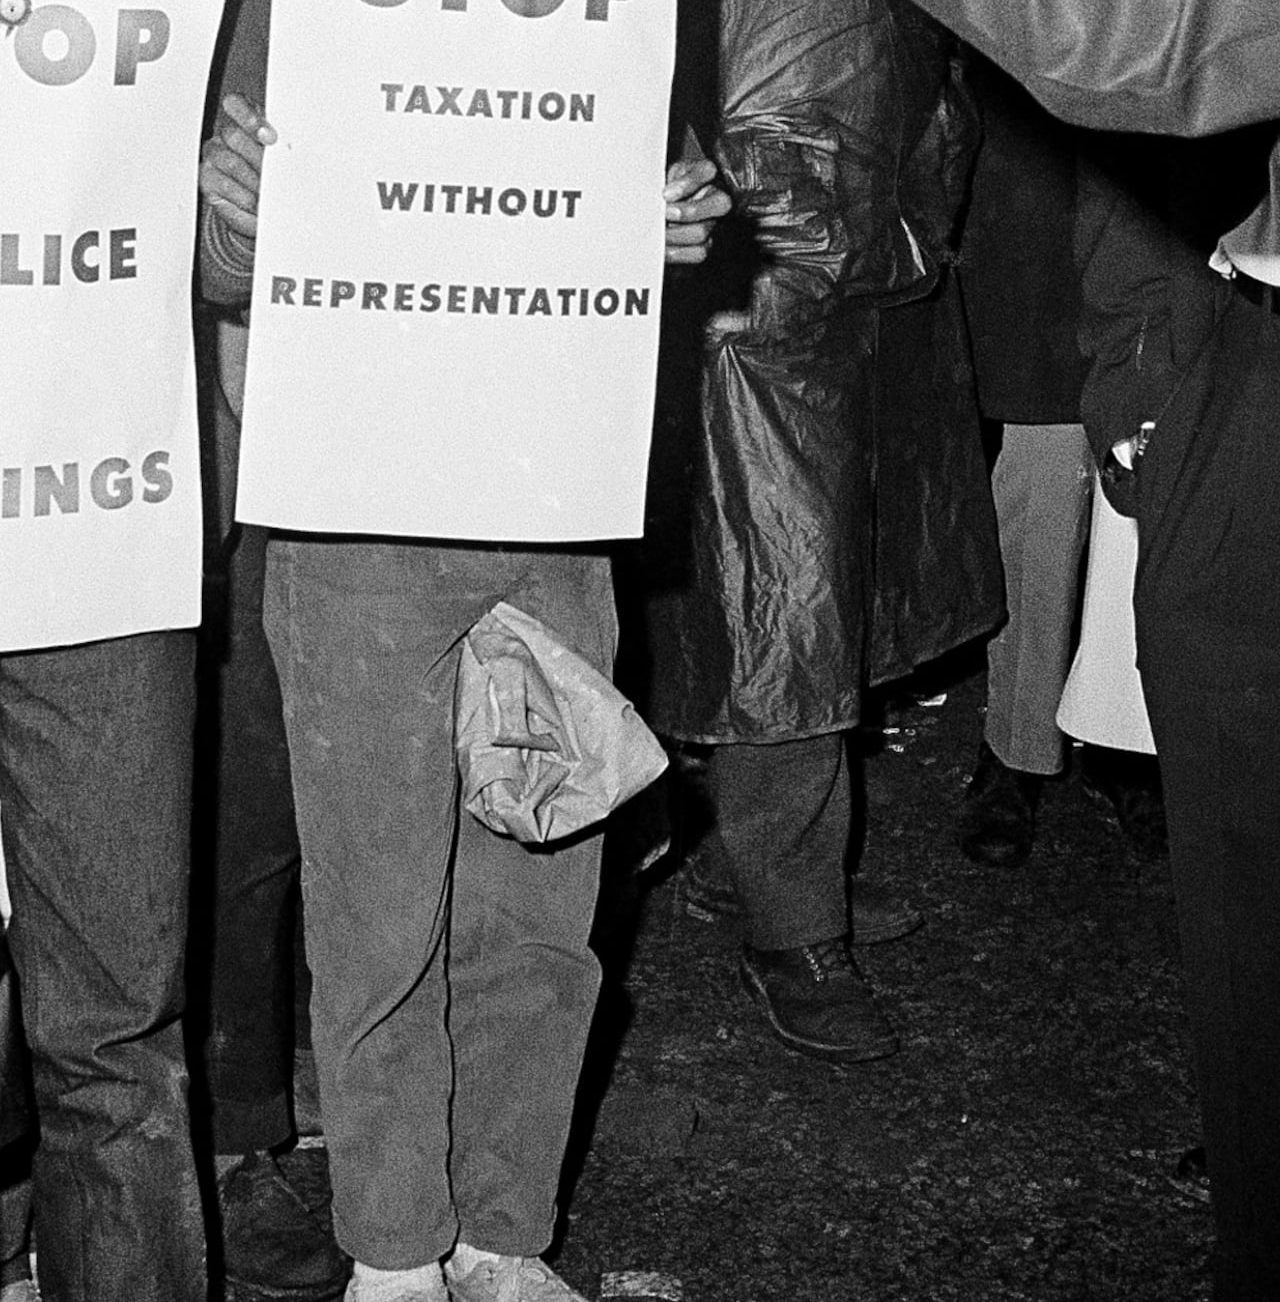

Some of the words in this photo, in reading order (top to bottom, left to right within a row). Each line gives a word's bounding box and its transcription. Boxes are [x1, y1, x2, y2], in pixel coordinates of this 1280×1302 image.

[380, 82, 596, 123] TAXATION
[376, 181, 582, 219] WITHOUT
[270, 275, 651, 317] REPRESENTATION
